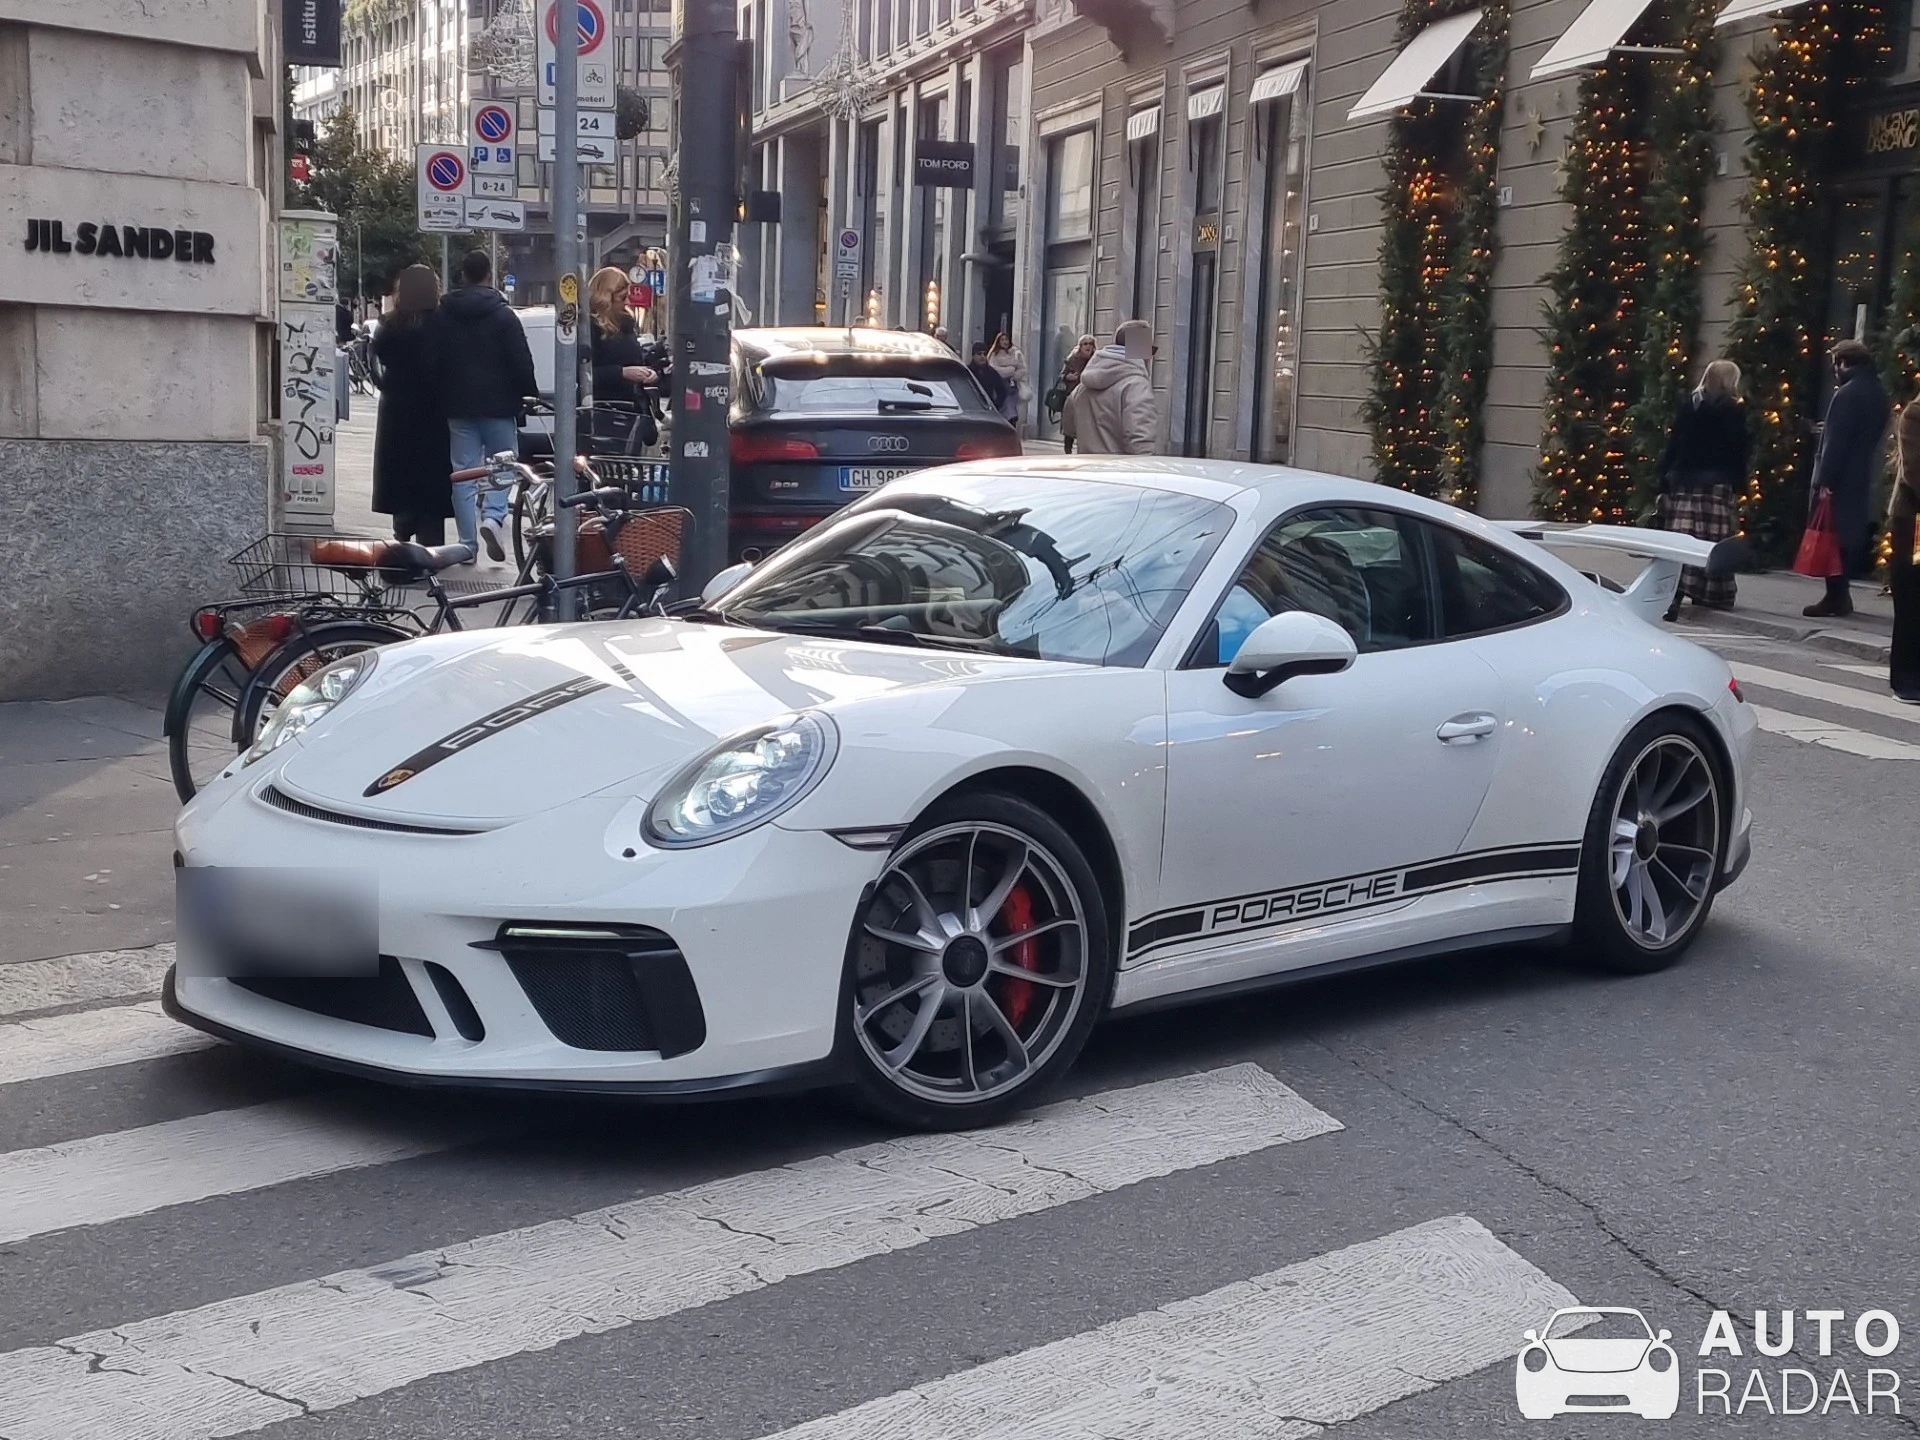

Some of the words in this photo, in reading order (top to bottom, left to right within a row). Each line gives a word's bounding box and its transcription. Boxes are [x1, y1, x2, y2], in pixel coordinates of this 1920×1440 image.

[482, 182, 505, 192] 0-24
[918, 158, 940, 169] TOM
[942, 160, 970, 170] FORD
[24, 218, 72, 253] JIL
[75, 221, 215, 264] SANDER
[440, 672, 606, 750] PORS
[1211, 873, 1399, 930] PORSCHE
